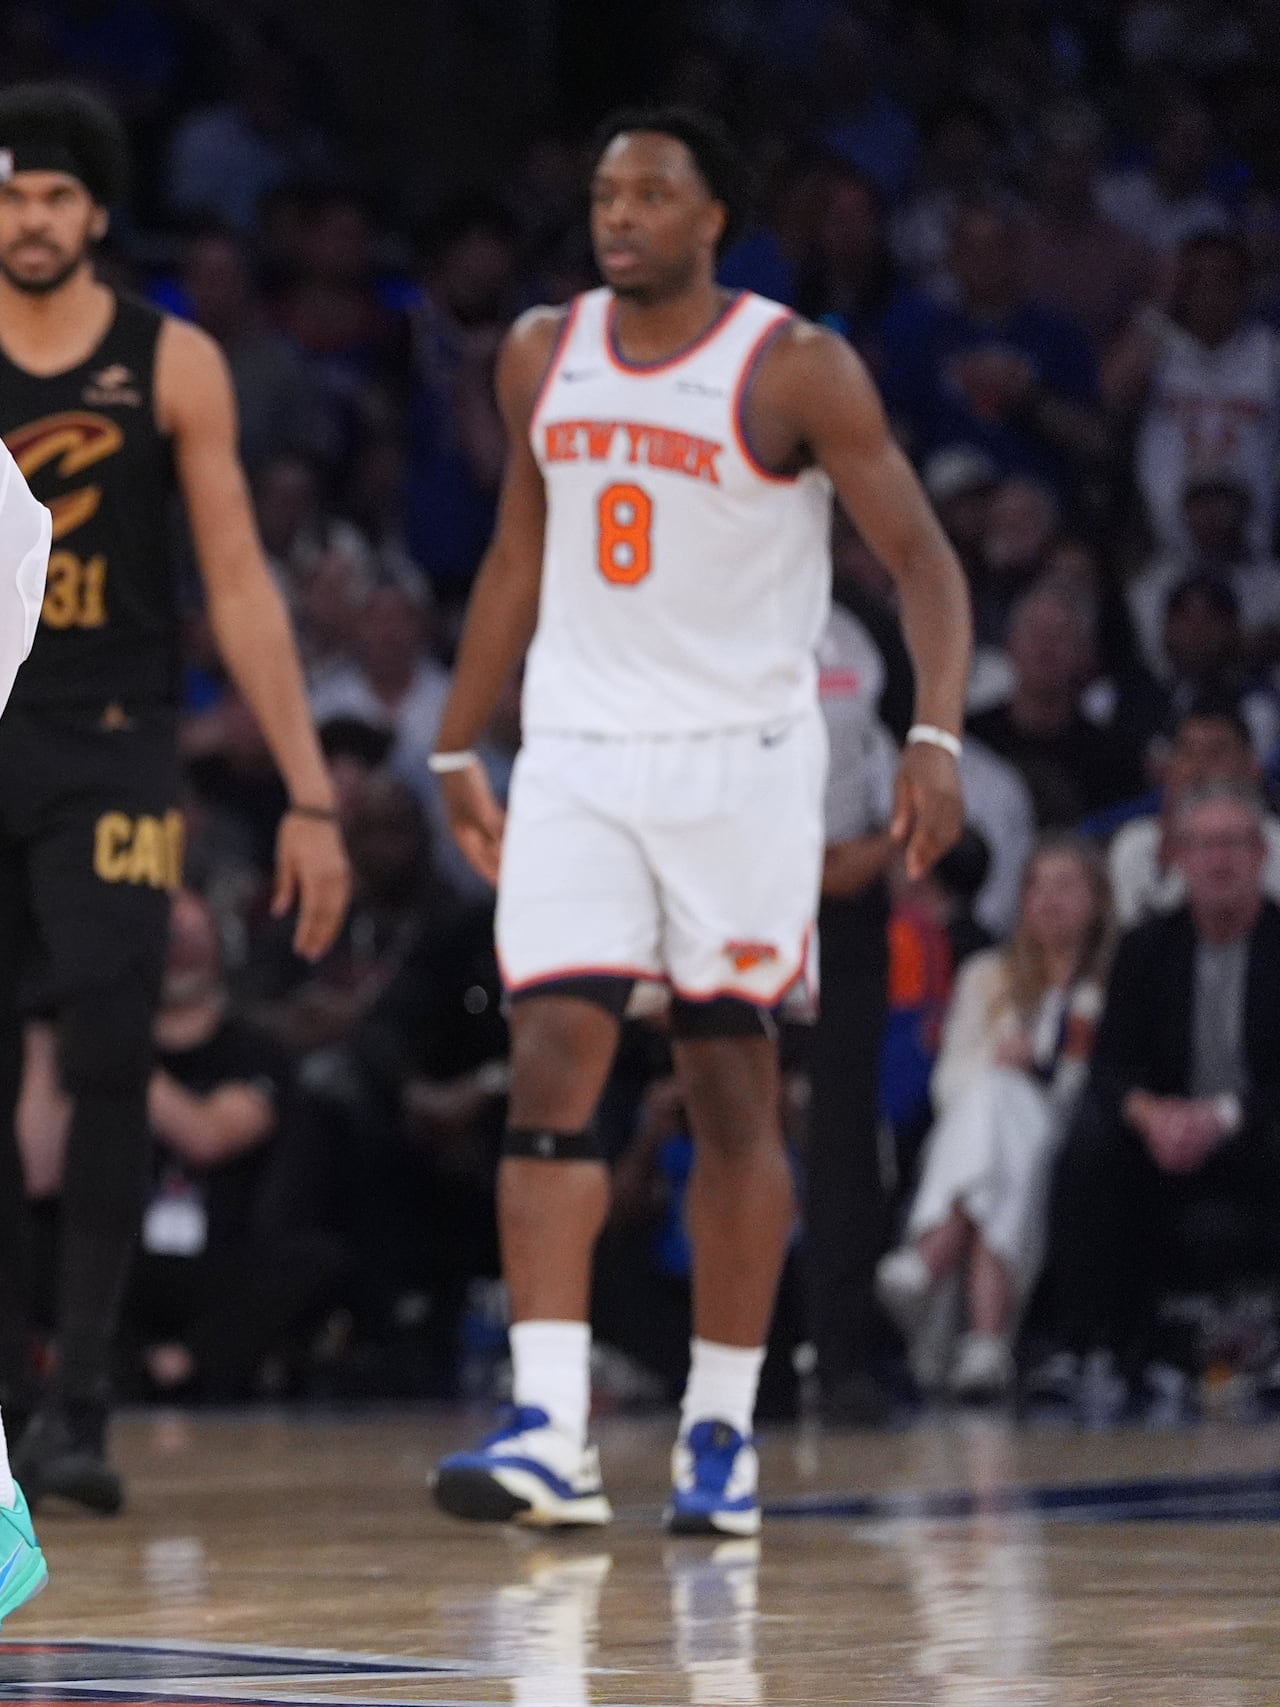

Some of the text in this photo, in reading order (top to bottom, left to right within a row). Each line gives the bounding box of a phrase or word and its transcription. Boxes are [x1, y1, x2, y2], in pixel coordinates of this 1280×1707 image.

[545, 418, 725, 486] NEW YORK
[597, 481, 653, 587] 8
[40, 552, 109, 630] 31
